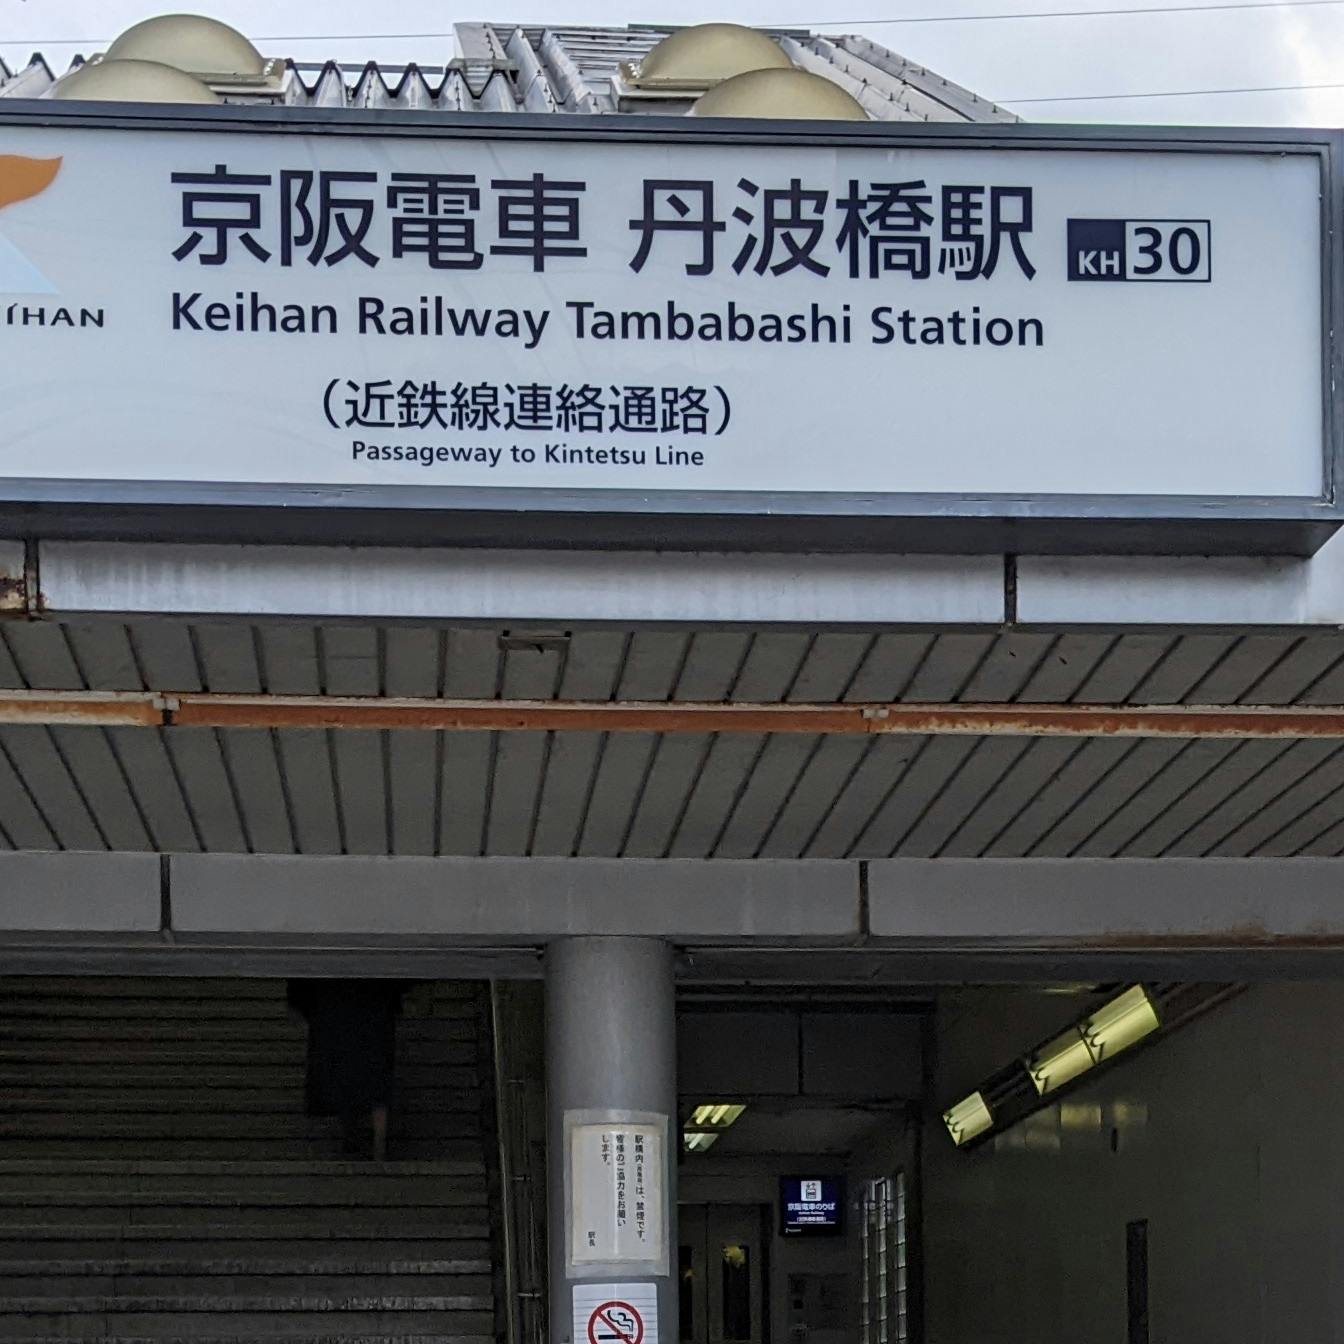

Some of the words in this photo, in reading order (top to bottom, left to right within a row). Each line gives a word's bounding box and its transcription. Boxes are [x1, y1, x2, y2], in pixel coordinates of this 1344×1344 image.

[170, 163, 588, 273] 京阪電車
[628, 177, 1037, 282] 丹波橋駅
[1078, 250, 1120, 275] KH
[1133, 226, 1201, 275] 30
[172, 291, 338, 334] Keihan
[358, 295, 551, 350] Railway
[565, 299, 851, 344] Tambabashi
[870, 305, 1044, 347] Station
[323, 378, 731, 436] （近鉄線連絡通路）
[352, 440, 503, 469] Passageway
[509, 444, 536, 464] to
[544, 442, 646, 465] Kintetsu
[655, 444, 705, 467] Line
